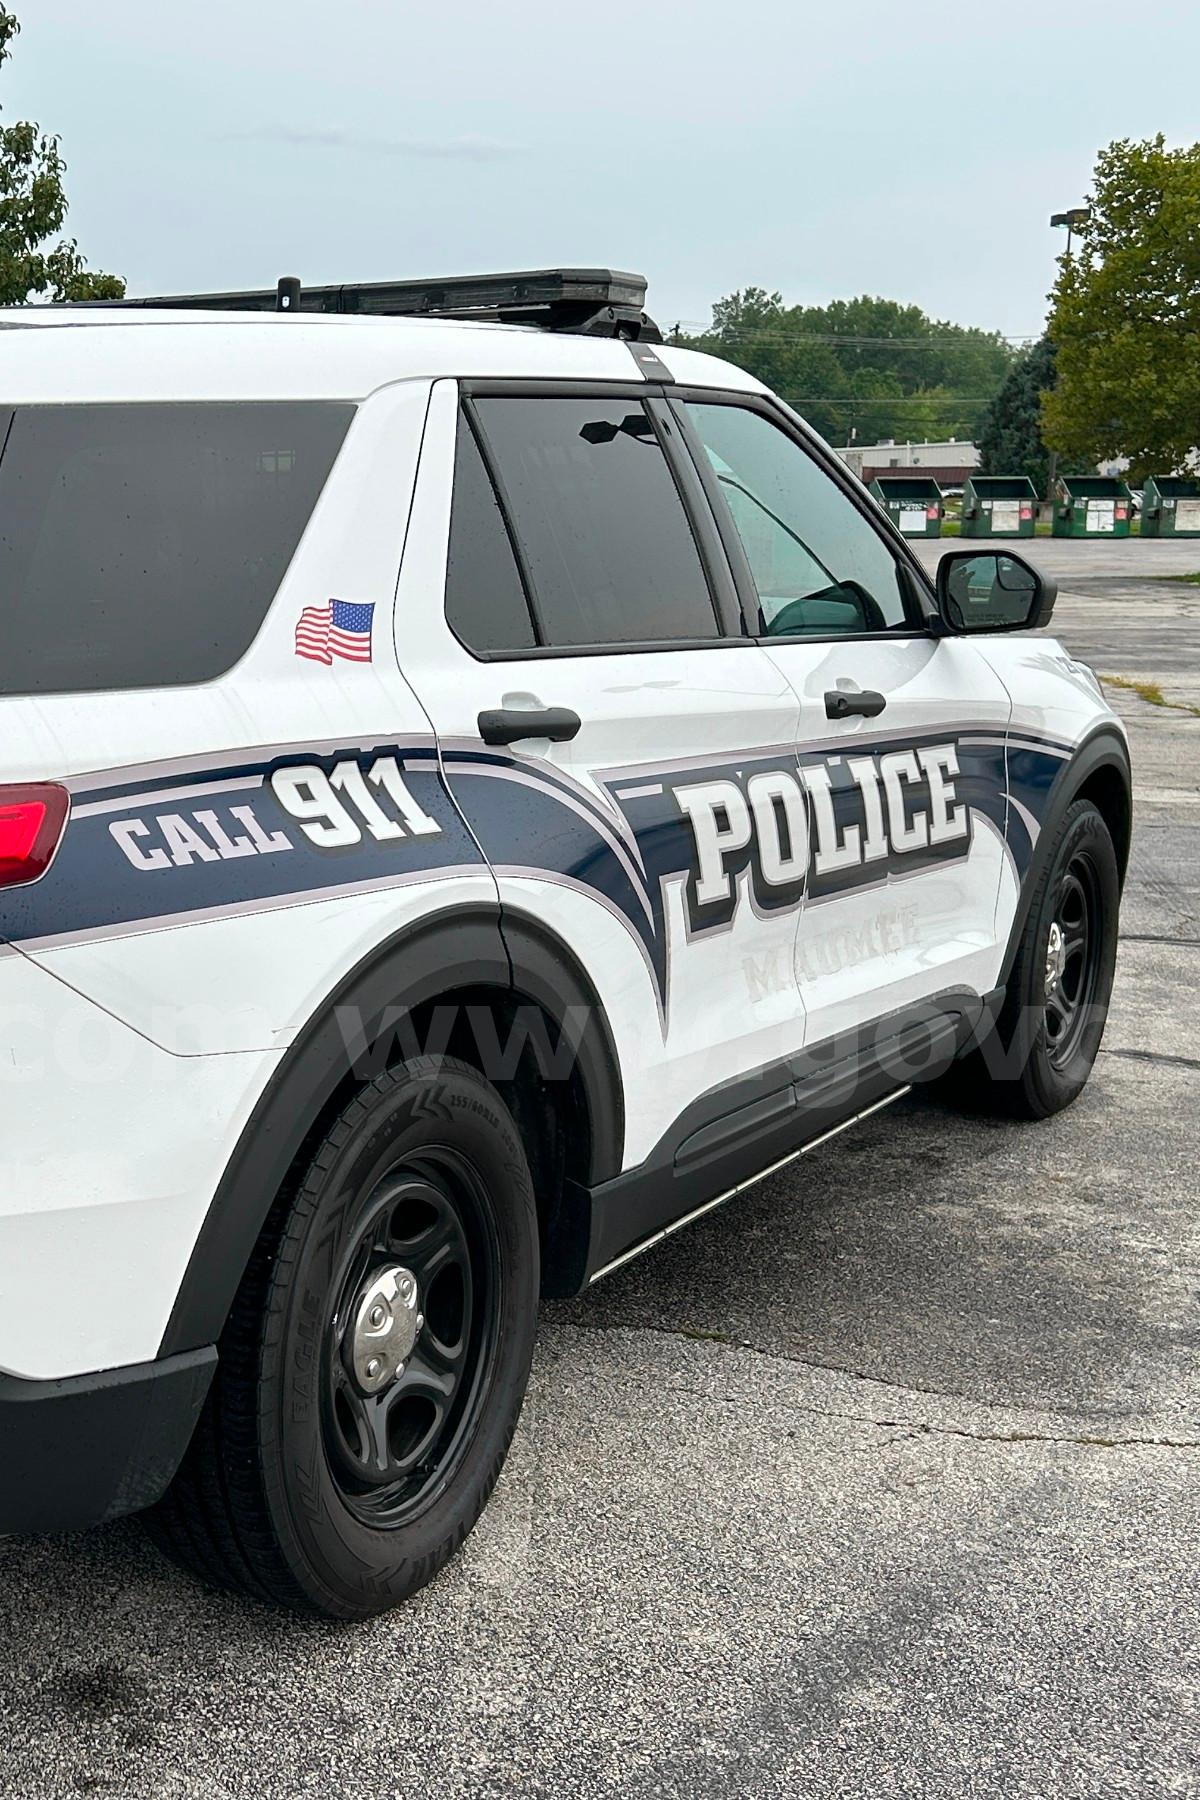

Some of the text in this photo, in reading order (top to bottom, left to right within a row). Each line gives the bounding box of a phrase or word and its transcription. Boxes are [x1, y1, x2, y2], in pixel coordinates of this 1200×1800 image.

[108, 756, 443, 871] CALL 911
[672, 742, 968, 906] POLICE
